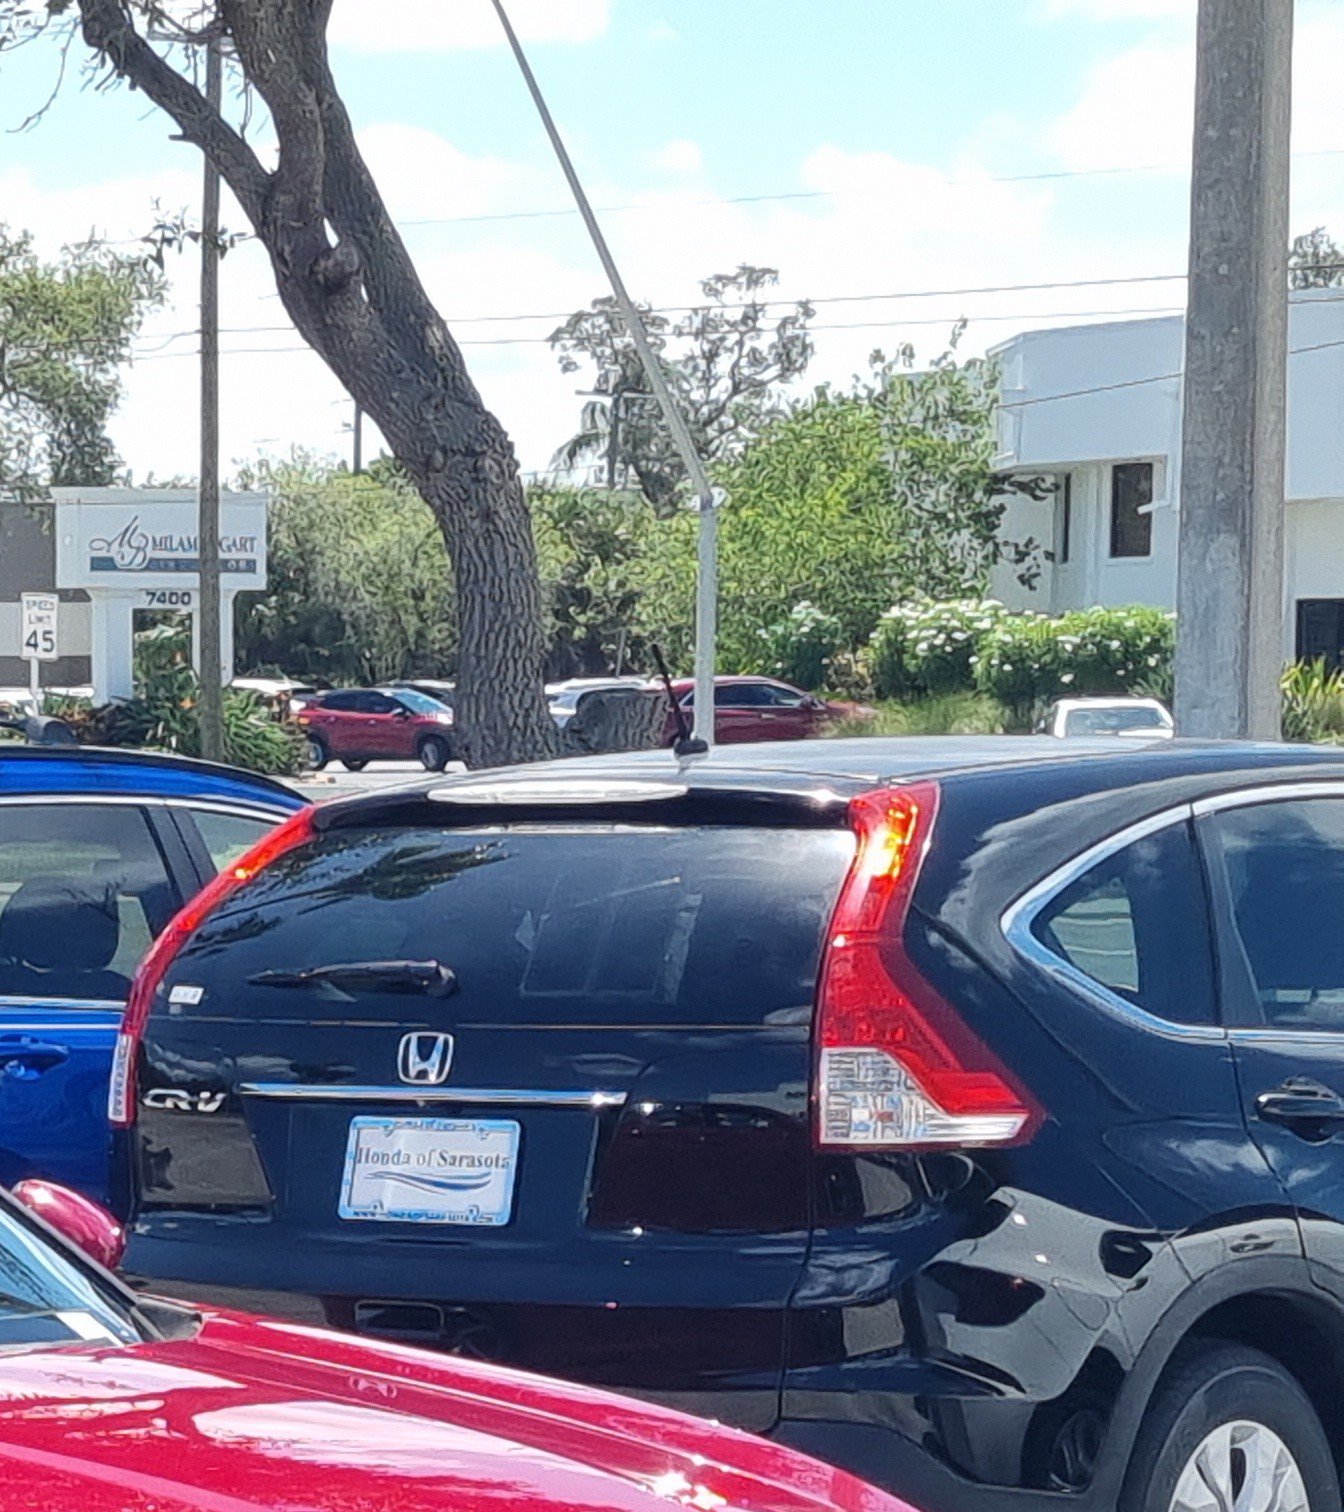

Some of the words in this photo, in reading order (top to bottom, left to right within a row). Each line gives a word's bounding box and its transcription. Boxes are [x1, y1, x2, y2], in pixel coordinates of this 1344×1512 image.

[145, 590, 192, 607] 7400
[25, 628, 55, 654] 45
[355, 1146, 411, 1167] Honda
[415, 1148, 437, 1168] of
[436, 1150, 511, 1170] Sarasota
